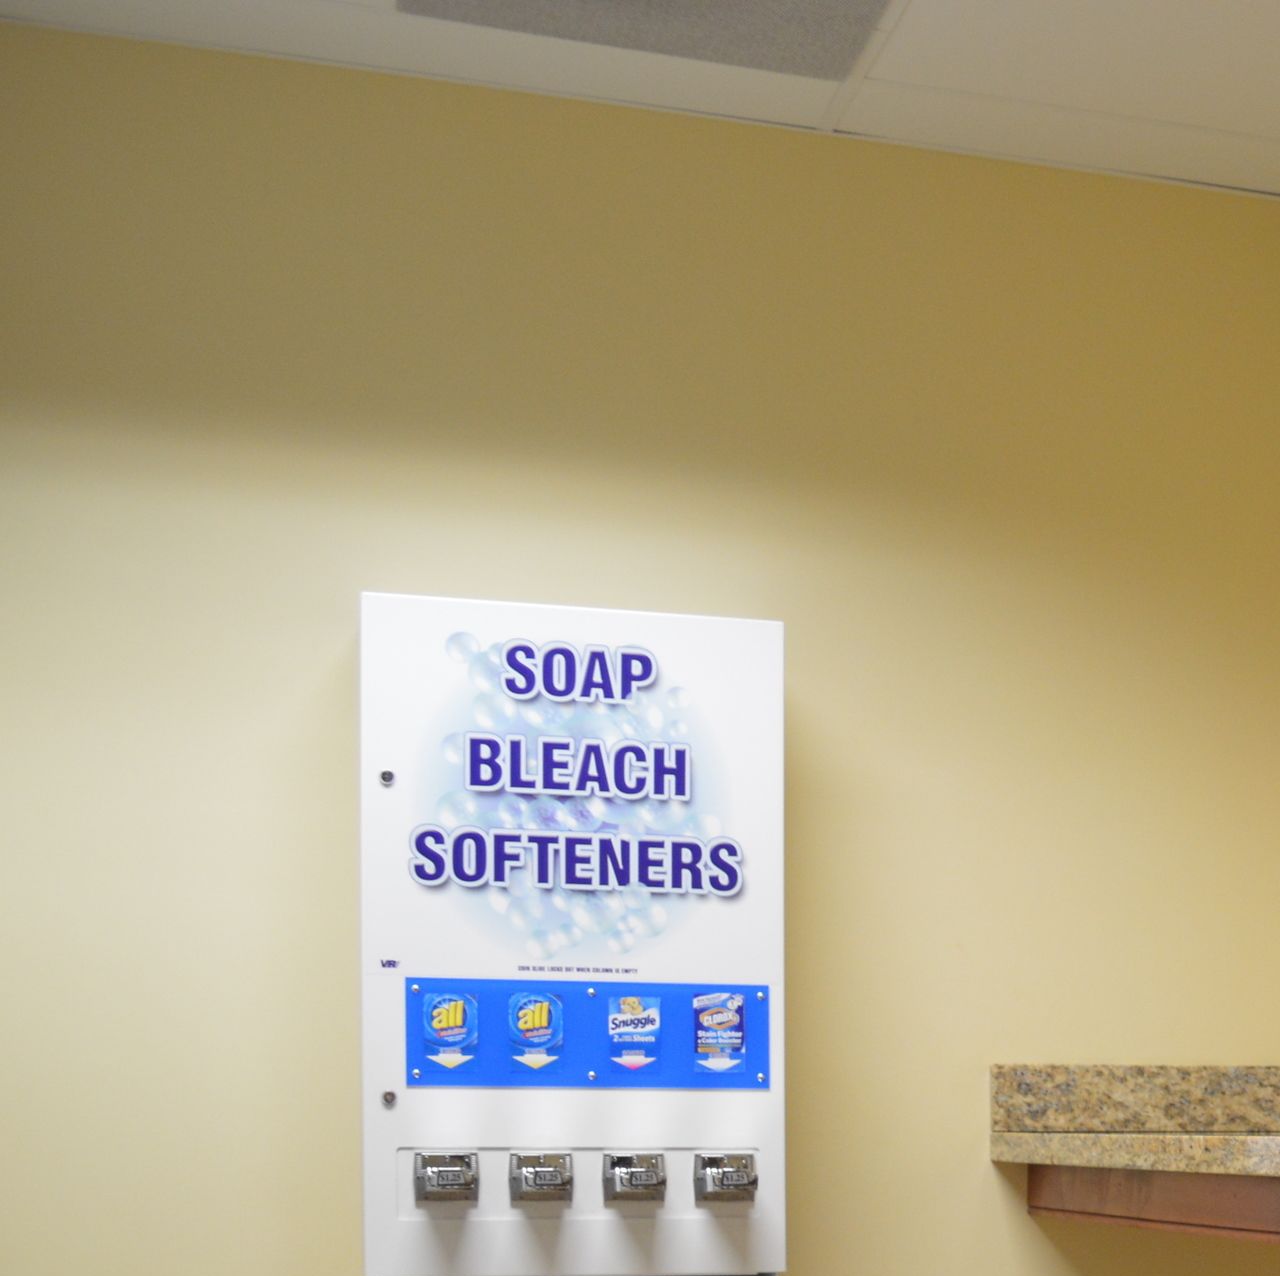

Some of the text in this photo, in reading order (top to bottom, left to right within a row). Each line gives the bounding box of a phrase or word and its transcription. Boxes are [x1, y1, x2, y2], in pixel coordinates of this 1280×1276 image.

[503, 643, 654, 700] SOAP
[468, 738, 687, 797] BLEACH
[413, 829, 740, 893] SOFTENERS
[431, 1000, 465, 1030] all
[517, 1001, 550, 1031] all
[611, 1016, 657, 1031] Snuggle
[439, 1174, 462, 1183] $1.25
[538, 1174, 558, 1182] $1.25
[634, 1174, 654, 1183] $1.25
[725, 1173, 745, 1182] $1.25
